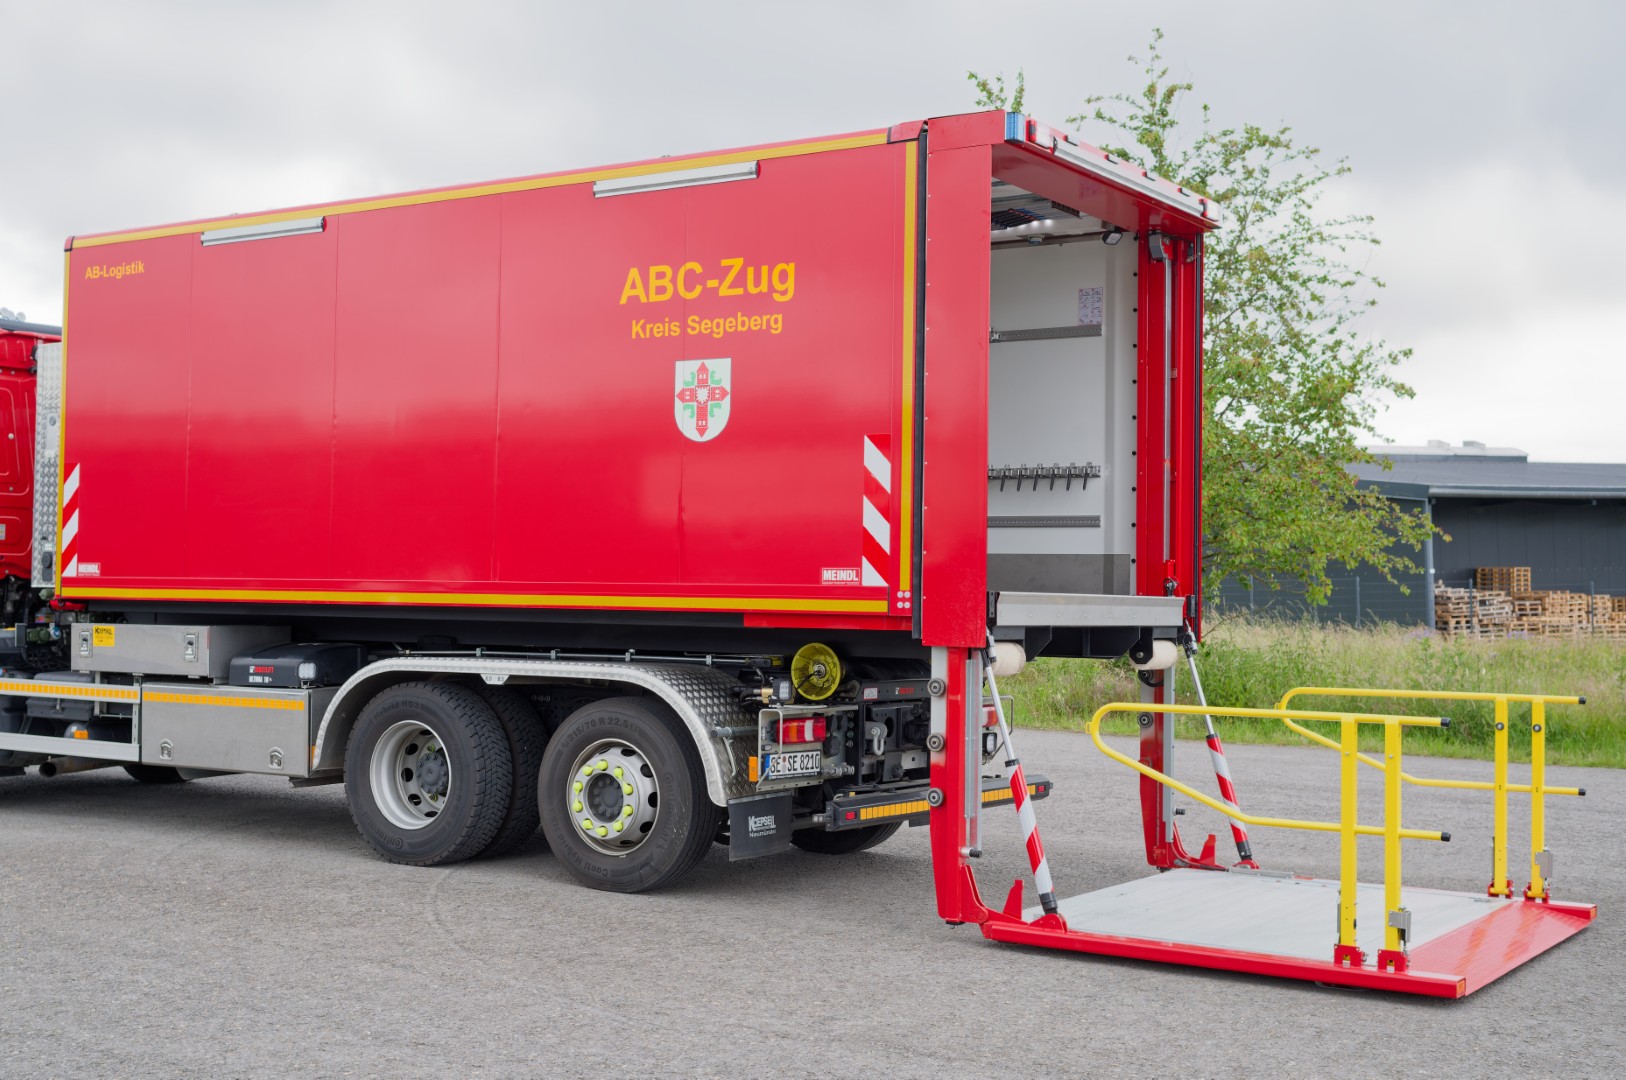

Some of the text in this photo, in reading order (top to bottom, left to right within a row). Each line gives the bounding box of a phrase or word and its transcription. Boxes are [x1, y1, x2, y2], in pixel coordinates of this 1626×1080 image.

[84, 260, 145, 280] AB-Logistik
[619, 257, 796, 305] ABC-Zug
[631, 311, 783, 339] Kreis Segeberg
[78, 563, 99, 573] MEINDL
[823, 569, 859, 581] MEINDL
[567, 716, 630, 742] 315/70 R 22.5
[787, 755, 798, 772] SE
[799, 753, 820, 771] 8210
[748, 815, 776, 831] KOEPSELL
